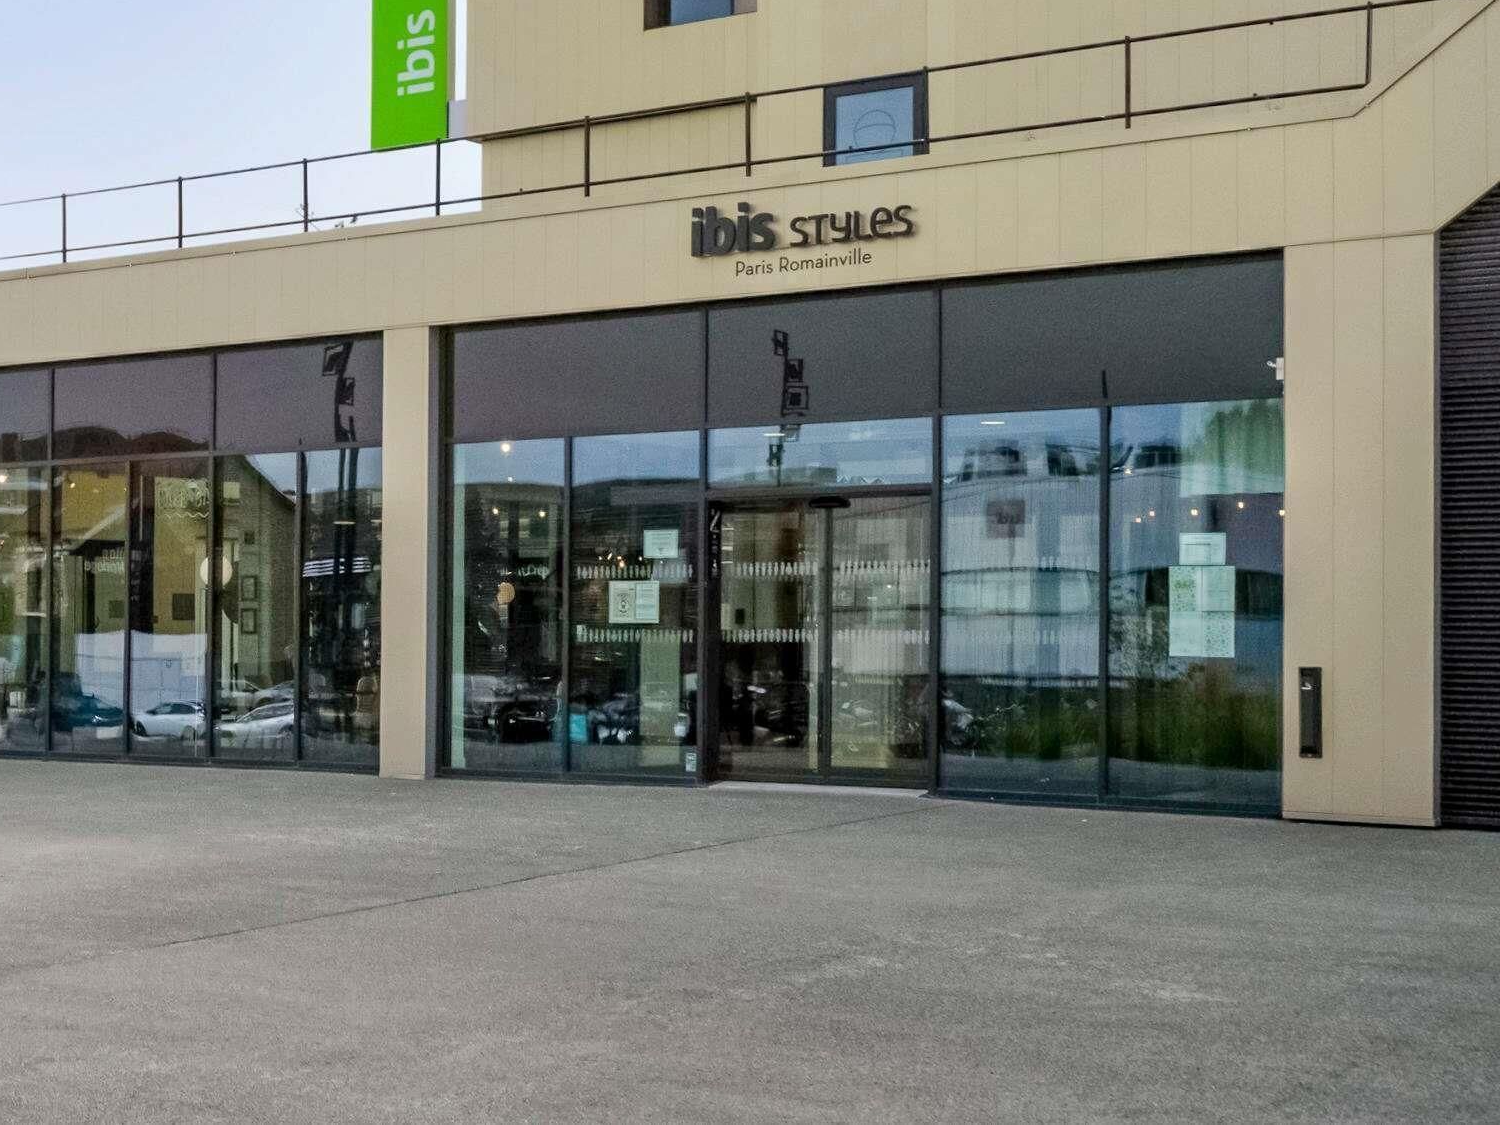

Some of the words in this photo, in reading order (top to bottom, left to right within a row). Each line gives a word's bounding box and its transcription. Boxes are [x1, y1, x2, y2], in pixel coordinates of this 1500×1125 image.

[397, 9, 436, 96] ibis
[691, 201, 777, 258] ibis
[735, 259, 774, 277] Paris
[779, 248, 873, 273] Romainville
